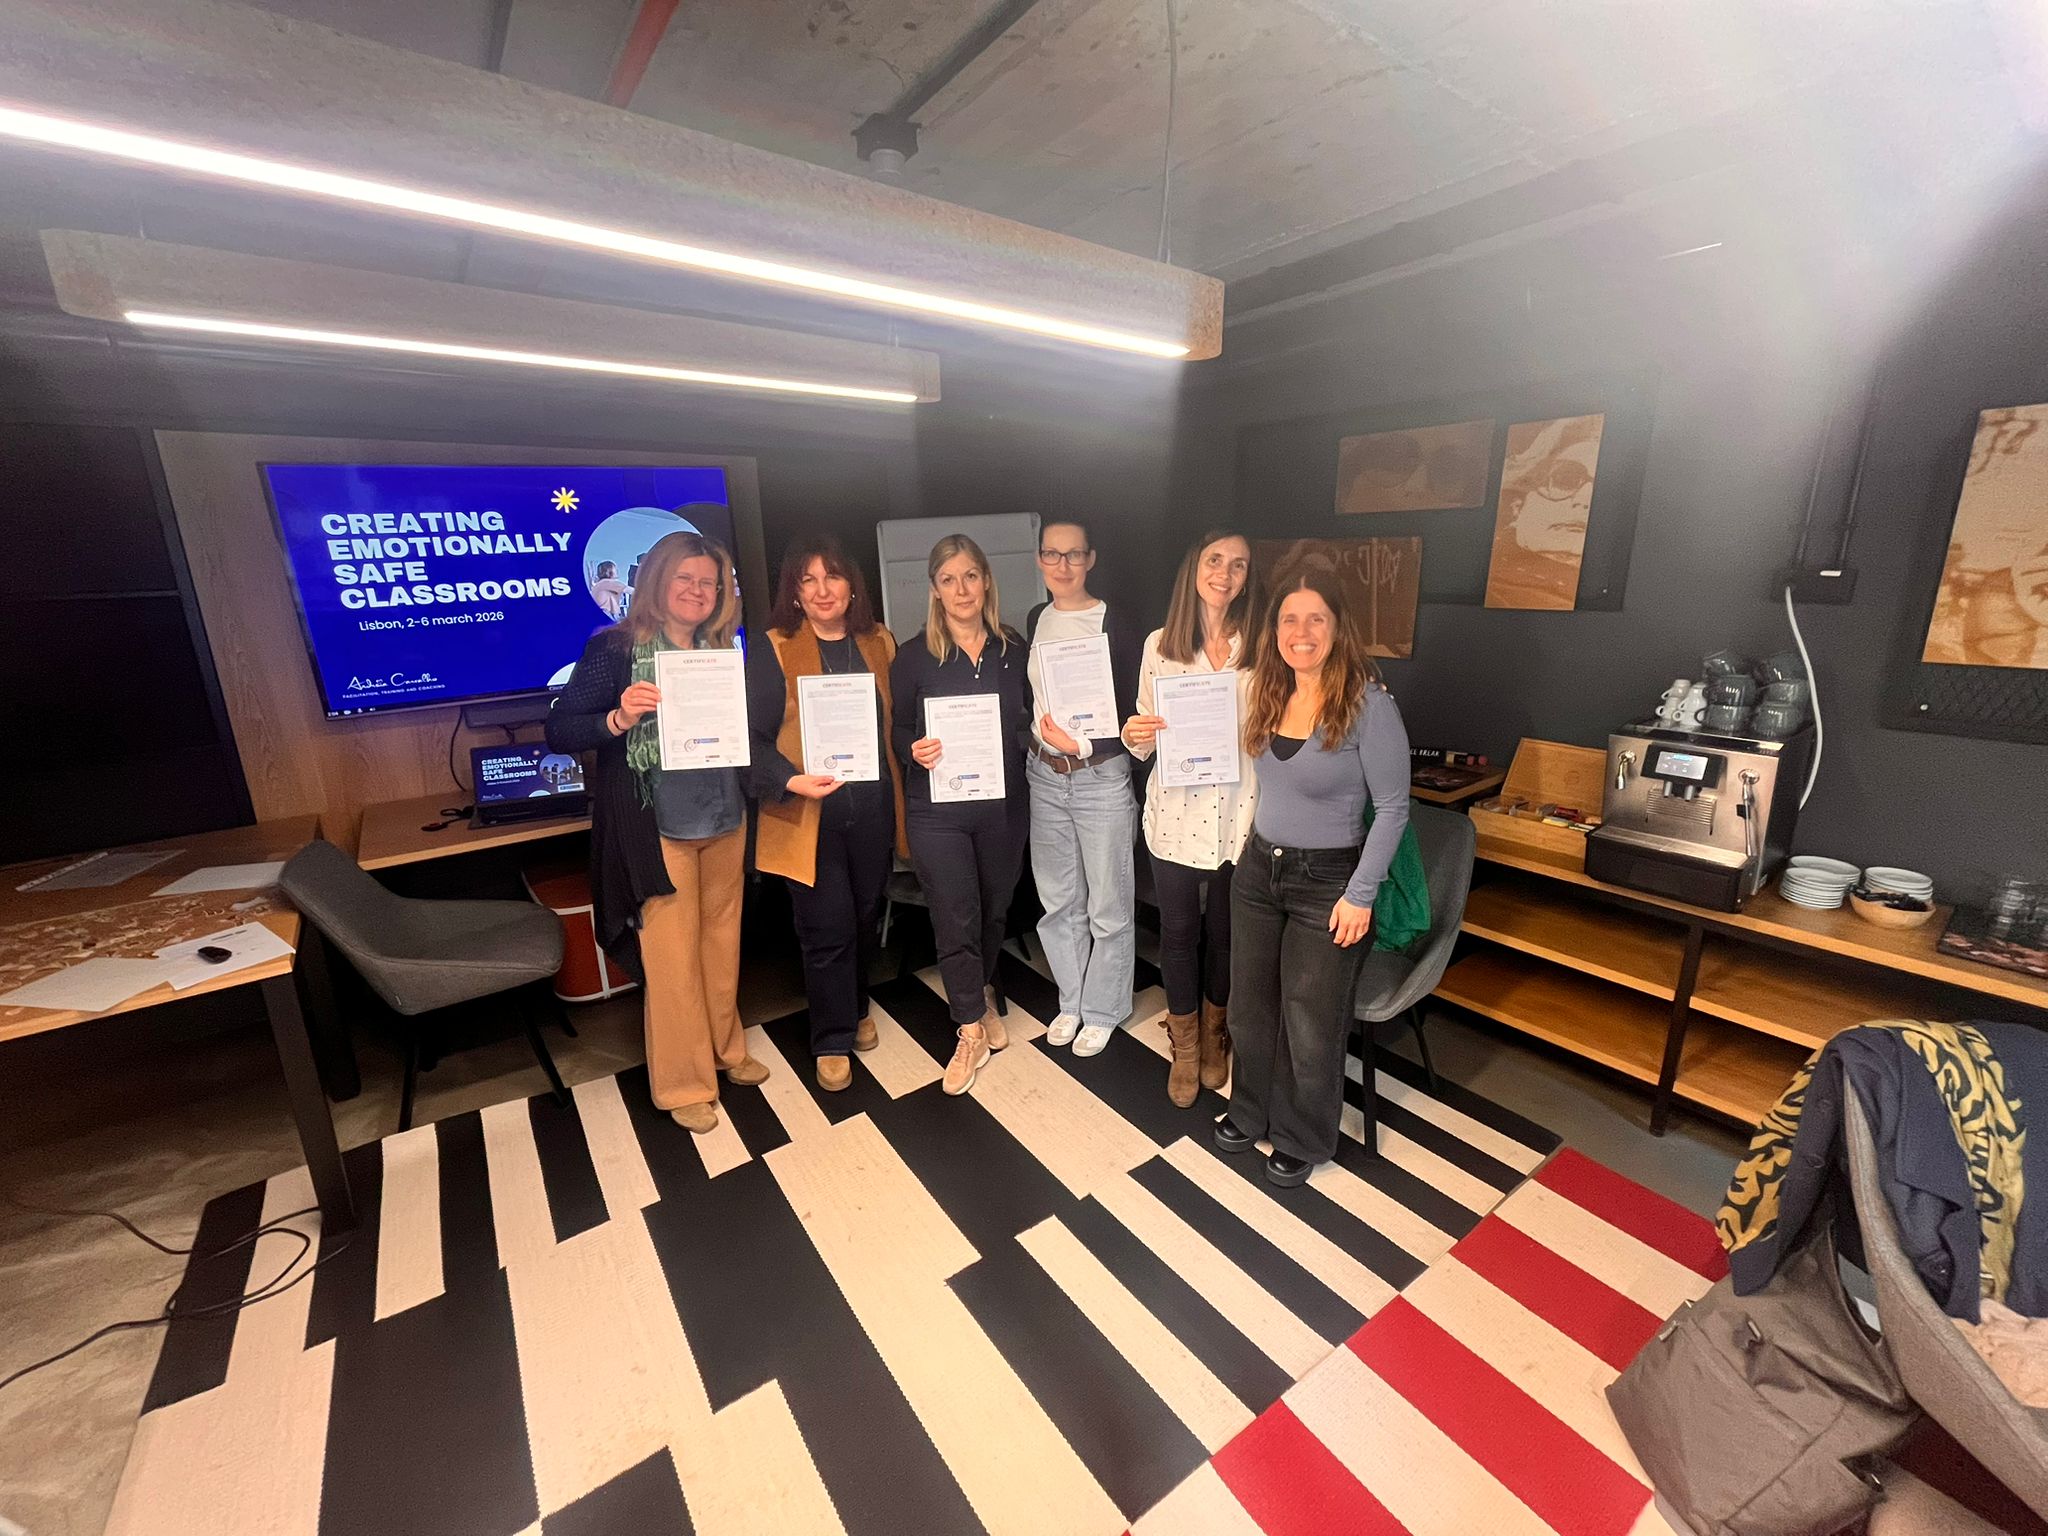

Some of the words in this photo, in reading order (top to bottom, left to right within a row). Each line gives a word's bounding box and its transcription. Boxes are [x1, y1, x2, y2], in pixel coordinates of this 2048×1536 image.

[321, 511, 505, 535] CREATING
[327, 532, 572, 560] EMOTIONALLY
[333, 561, 429, 585] SAFE
[340, 577, 571, 609] CLASSROOMS
[359, 620, 405, 631] Lisbon,
[406, 616, 430, 628] 2-6
[432, 613, 474, 625] march
[475, 611, 505, 622] 2026
[390, 672, 438, 687] Carvalho
[481, 756, 522, 766] CREATING
[482, 760, 538, 771] EMOTIONALLY
[482, 768, 503, 776] SAFE
[483, 770, 537, 782] CLASSROOMS
